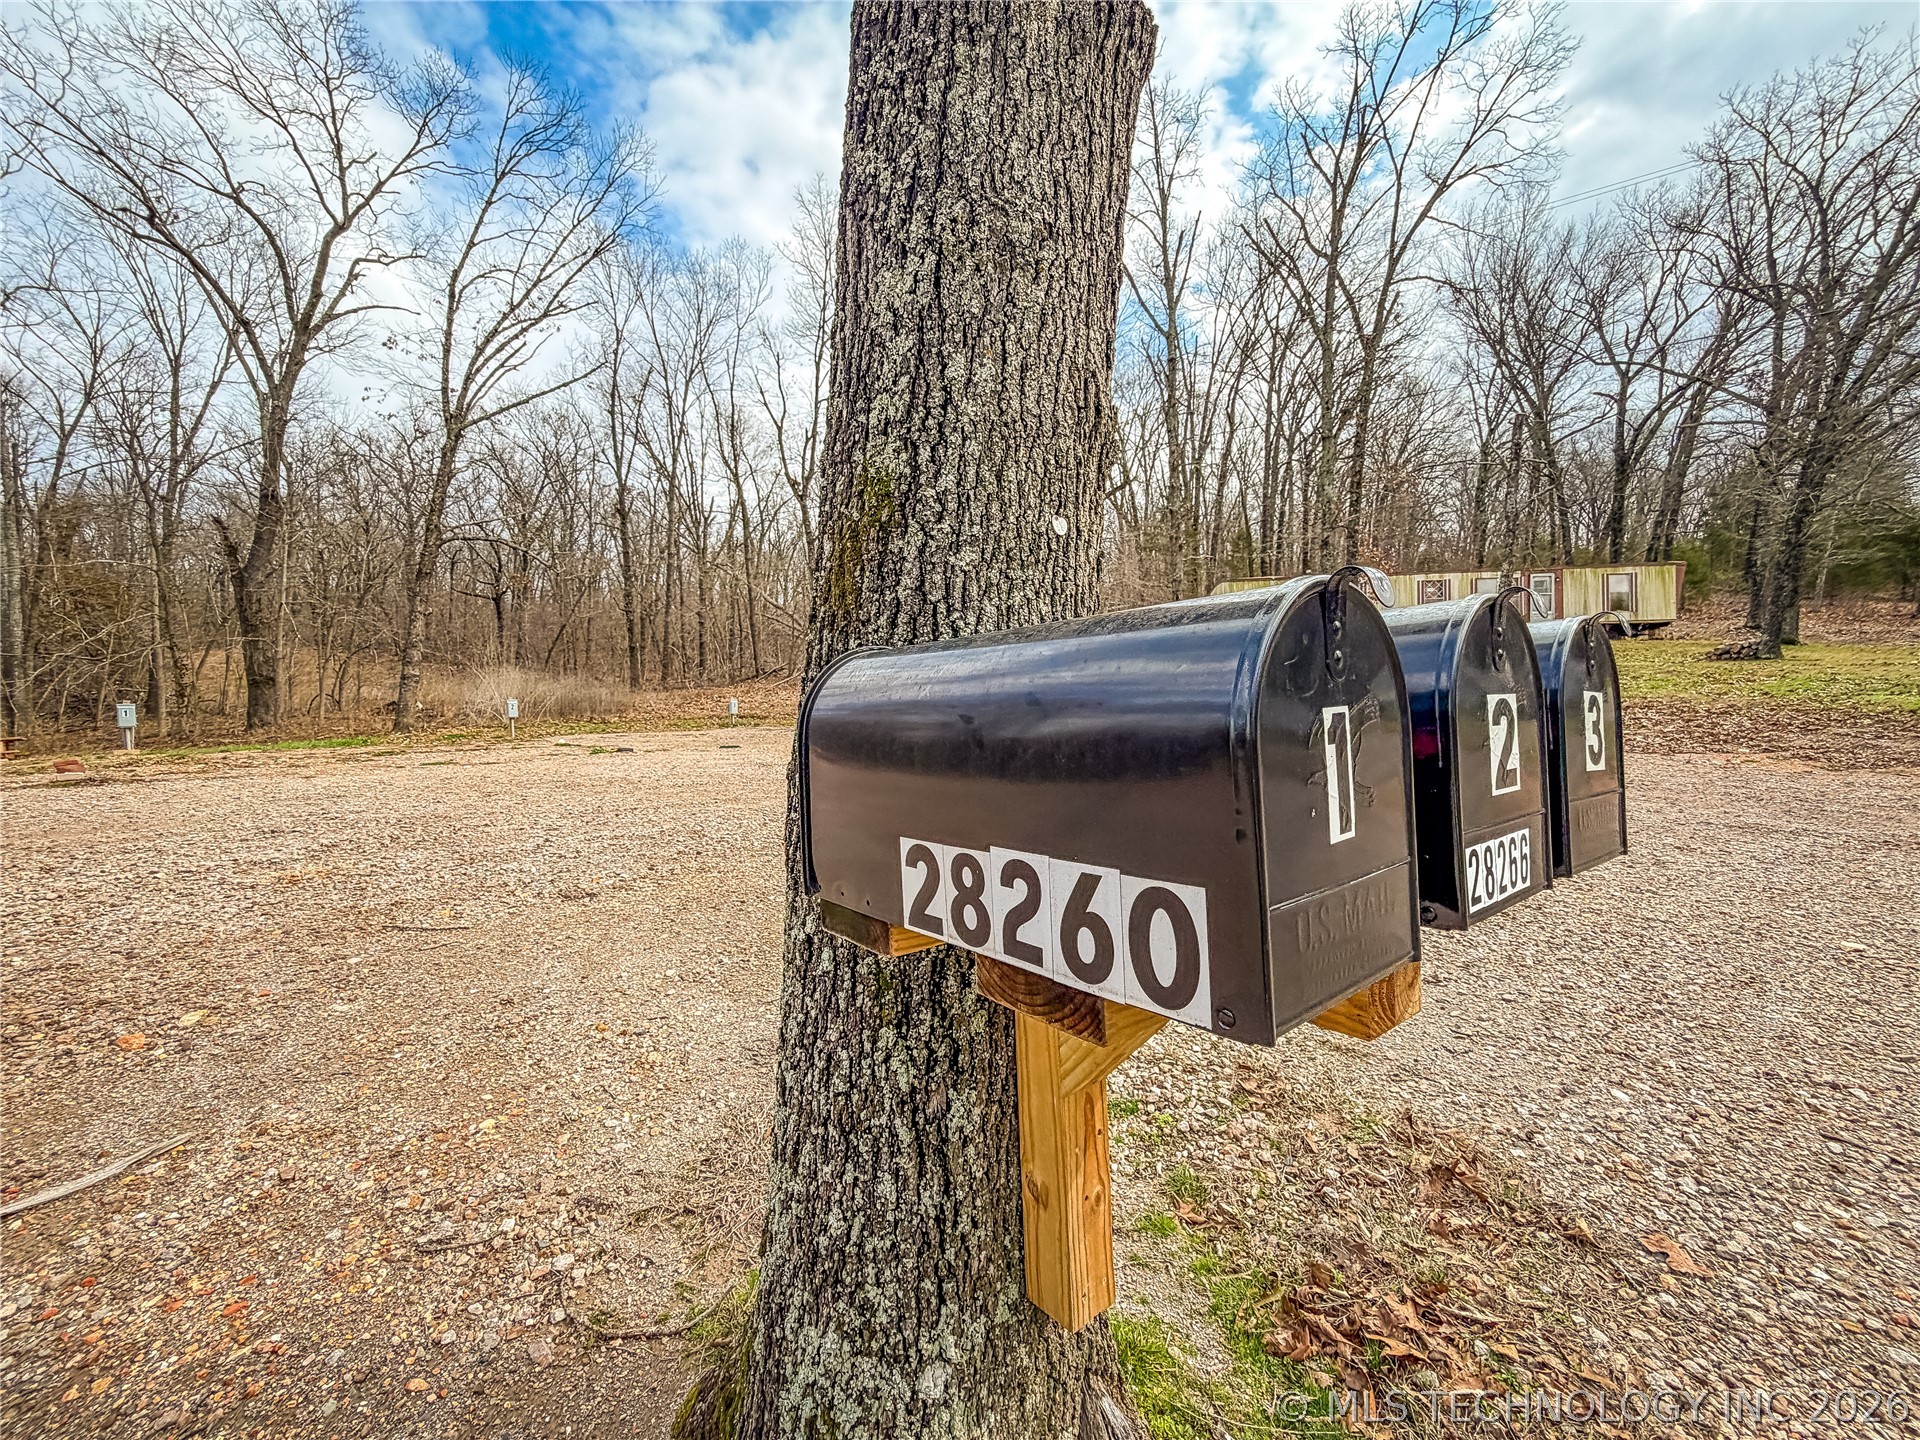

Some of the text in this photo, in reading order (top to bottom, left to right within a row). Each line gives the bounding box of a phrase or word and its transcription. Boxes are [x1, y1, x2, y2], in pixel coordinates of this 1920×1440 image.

[1327, 710, 1353, 836] 1
[1491, 697, 1519, 790] 2
[1586, 694, 1603, 766] 3
[1468, 831, 1530, 908] 28266
[905, 843, 1201, 1010] 28260
